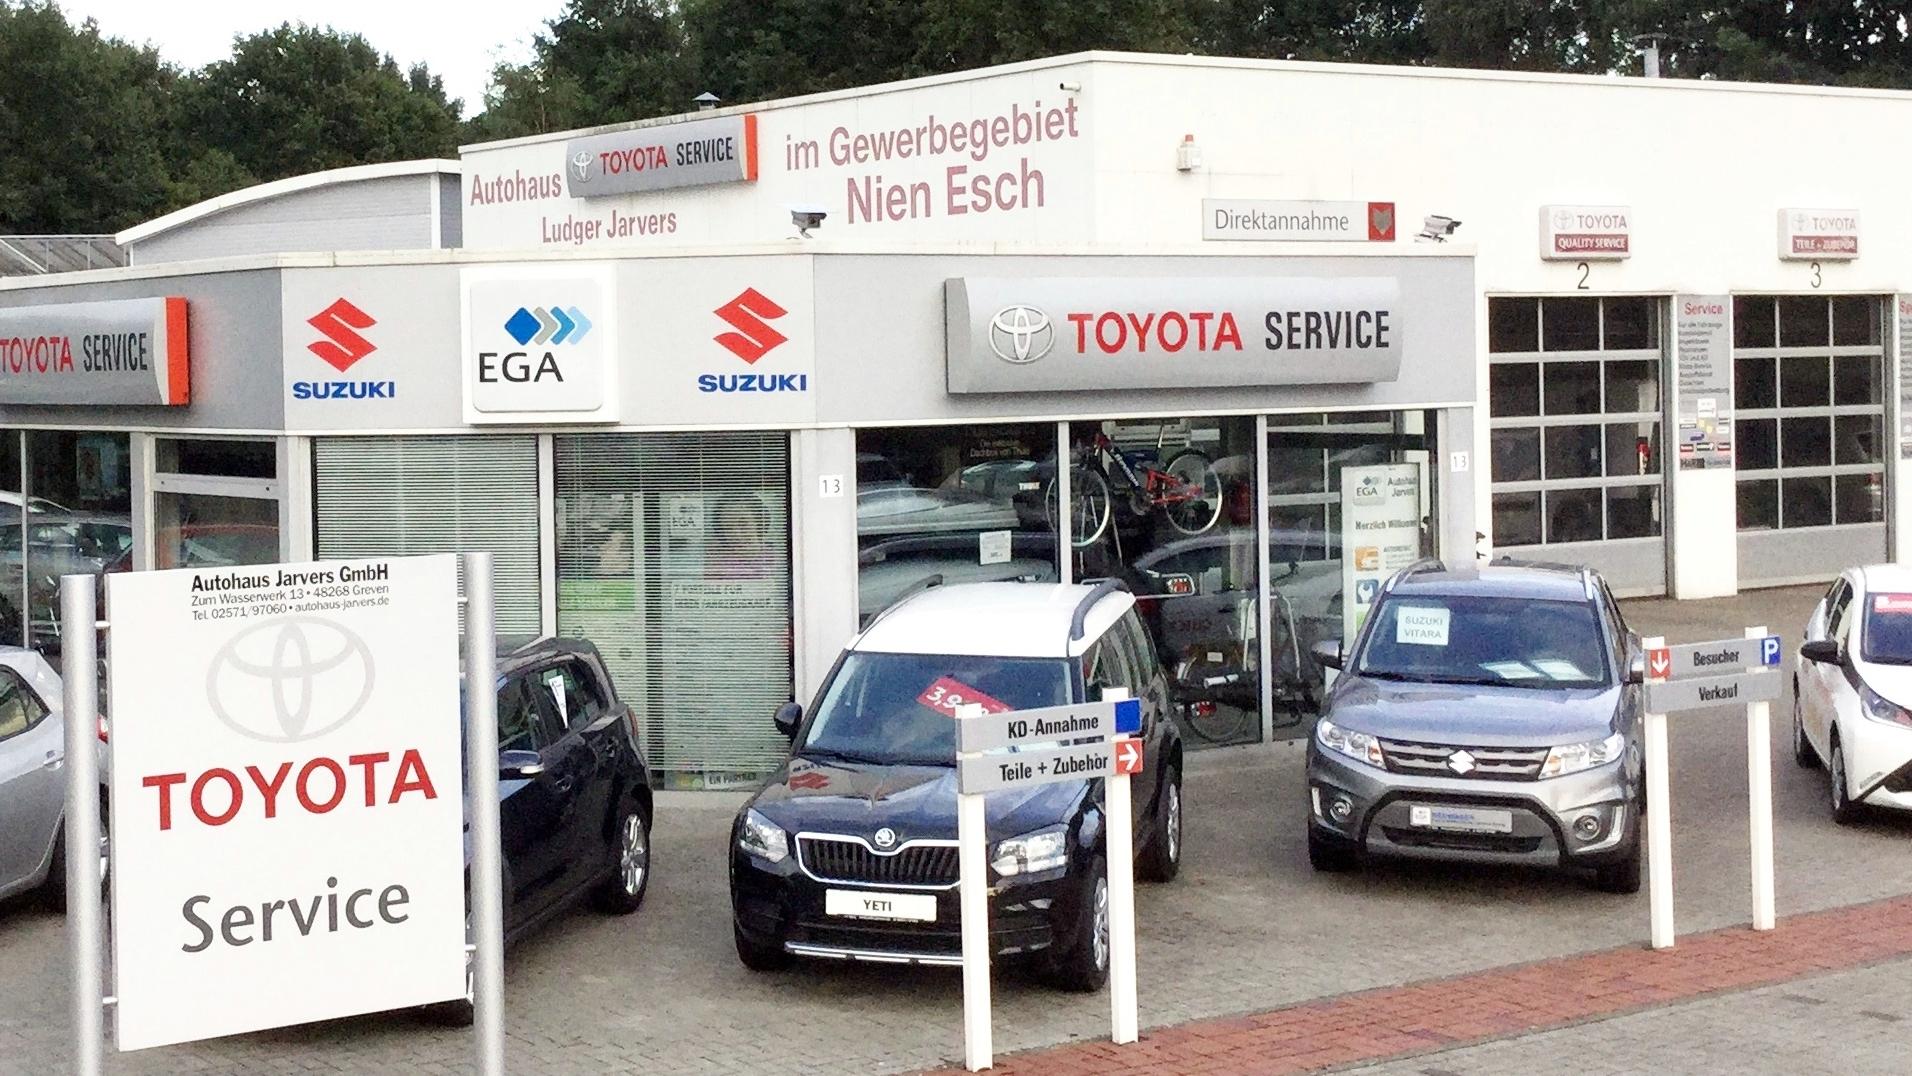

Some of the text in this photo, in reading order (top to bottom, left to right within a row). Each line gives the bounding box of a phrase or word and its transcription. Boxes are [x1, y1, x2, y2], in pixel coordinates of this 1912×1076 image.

[786, 97, 1078, 171] im Gewerbegebiet
[600, 137, 733, 175] TOYOTA SERVICE
[470, 169, 562, 206] Autohaus
[847, 158, 1044, 224] Nien Esch
[542, 209, 676, 245] Ludger Jarvers
[1215, 209, 1349, 231] Direktannahme
[1577, 215, 1627, 229] TOYOTA
[1812, 217, 1857, 231] TOYOTA
[1558, 237, 1626, 249] QUALITY SERVICE
[1577, 262, 1590, 289] 2
[1811, 262, 1822, 288] 3
[1684, 302, 1723, 316] Service
[1068, 310, 1390, 355] TOYOTA SERVICE
[0, 333, 148, 373] TOYOTA SERVICE
[478, 352, 564, 384] EGA
[292, 381, 395, 400] SUZUKI
[698, 373, 807, 393] SUZUKI
[1453, 455, 1467, 468] 13
[821, 479, 842, 494] 13
[1356, 487, 1378, 496] EGA
[191, 563, 389, 592] Autohaus Jarvers GmbH
[191, 584, 389, 606] Zum Wasserwerk 13 48268 Greven
[295, 595, 390, 612] autohaus-jarvers.de
[1405, 616, 1443, 626] SUZUKI
[1404, 629, 1442, 639] VITARA
[1694, 640, 1779, 666] Besucher P
[1699, 682, 1738, 701] Verkauf
[1008, 714, 1099, 739] KD-Annahme
[1000, 752, 1108, 782] Teile + Zubehör
[143, 748, 438, 831] TOYOTA
[182, 877, 410, 953] Service
[863, 899, 892, 911] YETI
